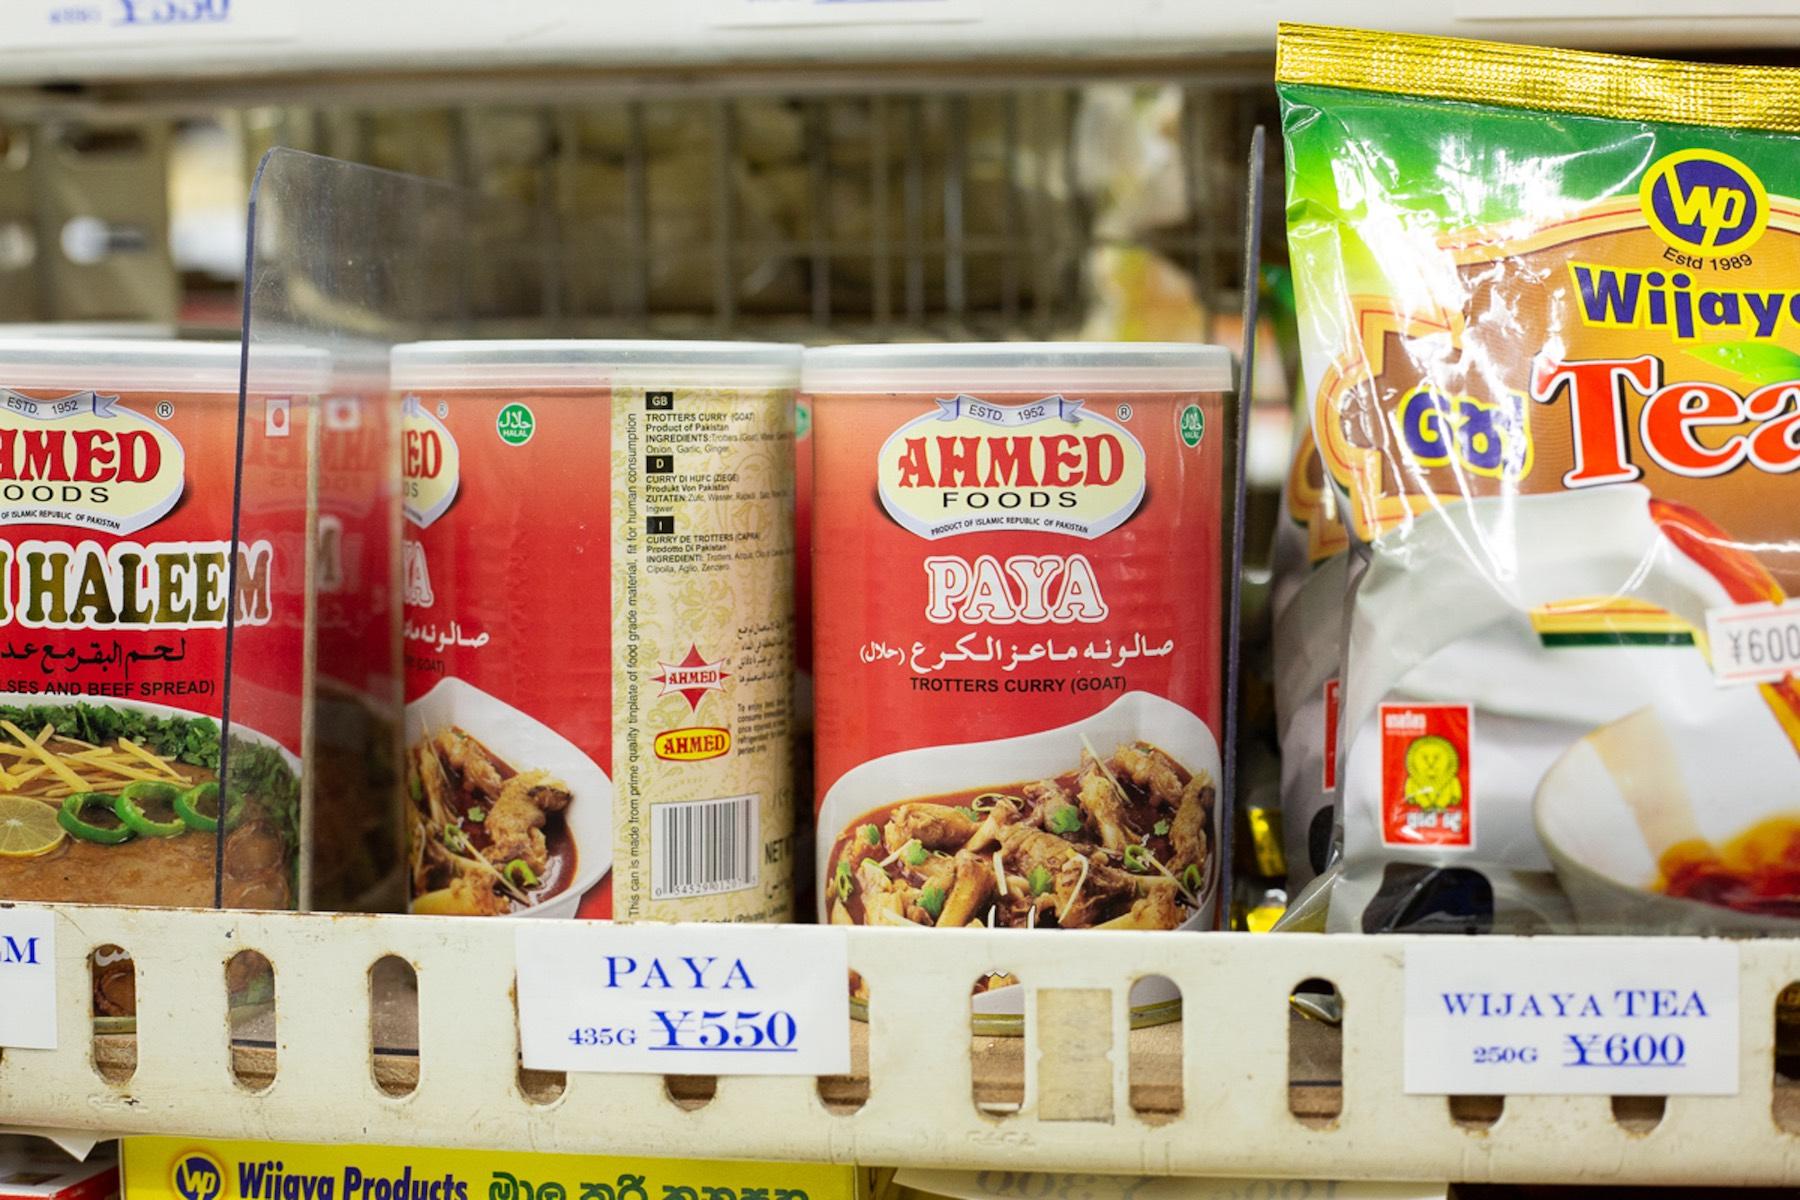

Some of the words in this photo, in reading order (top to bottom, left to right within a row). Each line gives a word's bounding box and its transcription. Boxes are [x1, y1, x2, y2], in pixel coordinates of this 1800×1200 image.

[1663, 247, 1704, 270] Estd
[1710, 254, 1753, 272] 1989
[1573, 267, 1800, 338] Wijay
[7, 397, 39, 416] ESTD.
[52, 401, 79, 415] 1952
[652, 397, 668, 407] GB
[646, 413, 696, 422] TROTTERS
[698, 413, 727, 422] CURRY
[968, 404, 1004, 422] ESTD.
[1017, 405, 1046, 421] 1952
[503, 428, 528, 438] HALAL
[646, 424, 682, 432] Product
[684, 423, 693, 432] of
[695, 423, 729, 432] Pakistan
[626, 413, 639, 482] consumption
[656, 459, 664, 469] D
[898, 434, 1125, 488] AHMED
[646, 475, 678, 484] CURRY
[646, 485, 680, 493] Produkt
[681, 484, 696, 492] Von
[698, 483, 730, 492] Pakistan
[3, 485, 109, 503] OODS
[943, 491, 1078, 509] FOODS
[627, 486, 637, 524] human
[646, 505, 673, 513] Ingwer
[12, 510, 38, 518] ISLAMIC
[39, 510, 72, 520] REPUBLIC
[87, 515, 121, 530] PAKISTAN
[930, 520, 963, 536] PRODUCT
[964, 519, 974, 529] OF
[975, 517, 1004, 526] ISLAMIC
[1006, 517, 1041, 526] REPUBLIC
[1044, 519, 1054, 527] OF
[1055, 520, 1089, 534] PAKISTAN
[627, 527, 637, 541] for
[646, 536, 678, 544] CURRY
[680, 535, 691, 544] DE
[693, 533, 734, 542] TROTTERS
[627, 545, 637, 555] fit
[685, 544, 694, 552] Di
[695, 543, 727, 552] Pakistan
[20, 545, 272, 629] HALEEM
[925, 555, 1107, 623] PAYA
[628, 610, 640, 641] grade
[1726, 624, 1800, 665] ¥600
[628, 644, 638, 669] food
[628, 671, 638, 682] of
[668, 670, 718, 685] AHMED
[910, 677, 999, 693] TROTTERS
[1004, 678, 1067, 693] CURRY
[1070, 676, 1127, 694] (GOAT)
[0, 680, 39, 695] SES
[44, 682, 81, 696] AND
[88, 682, 135, 697] BEEF
[140, 680, 216, 697] SPREAD)
[628, 685, 640, 724] tinplate
[628, 728, 640, 763] quality
[663, 734, 726, 754] AHMED
[628, 766, 640, 796] prime
[628, 799, 638, 824] from
[628, 827, 638, 857] made
[628, 859, 638, 869] is
[628, 895, 638, 917] This
[604, 956, 757, 990] PAYA
[1441, 990, 1604, 1019] WIJAYA
[1613, 988, 1709, 1018] TEA
[567, 1027, 637, 1047] 435G
[648, 1009, 799, 1051] ¥550
[1473, 1043, 1538, 1065] 250G
[1562, 1033, 1687, 1068] ¥600
[343, 1165, 468, 1200] Products
